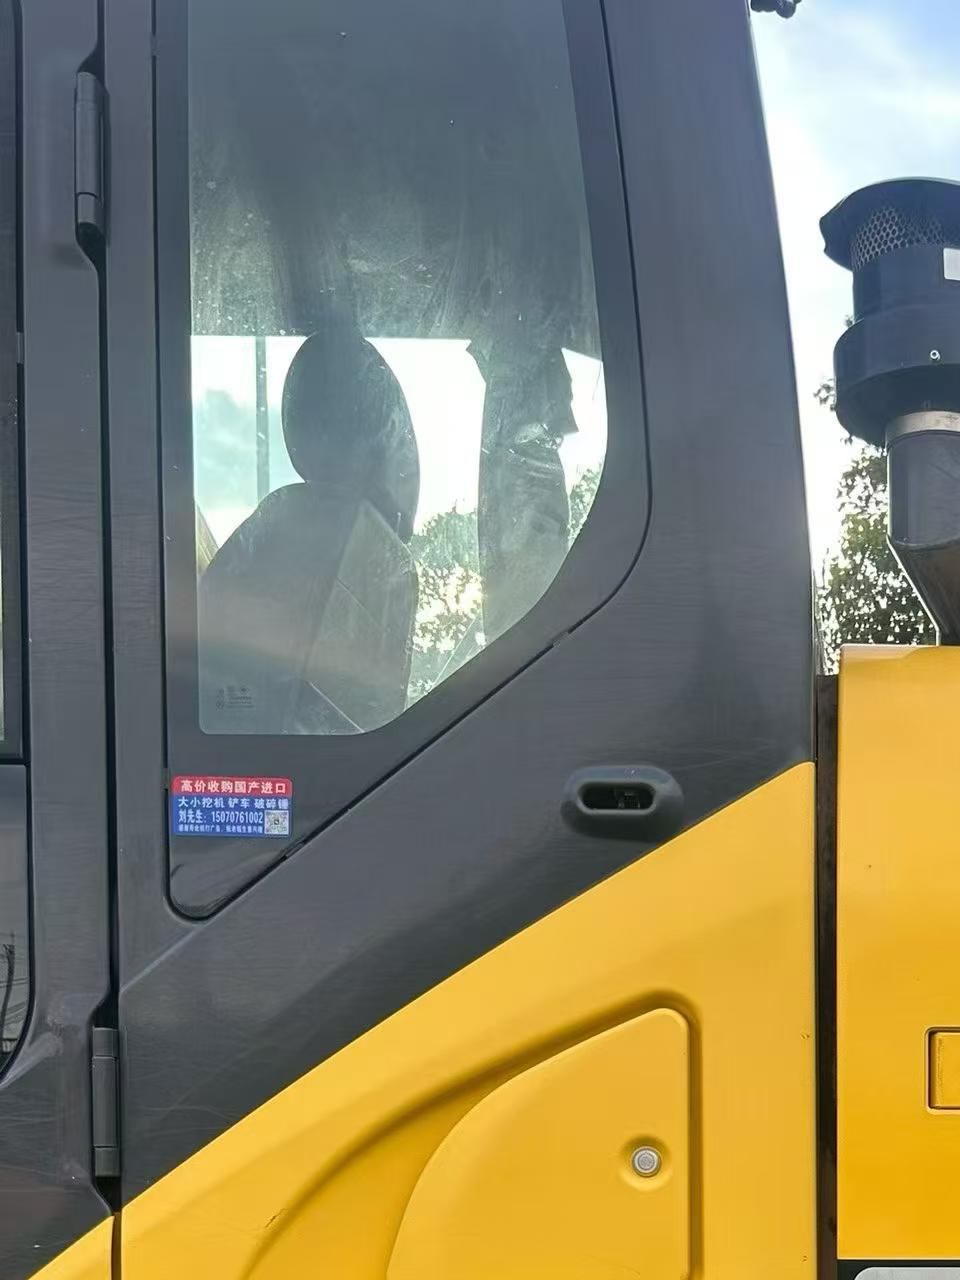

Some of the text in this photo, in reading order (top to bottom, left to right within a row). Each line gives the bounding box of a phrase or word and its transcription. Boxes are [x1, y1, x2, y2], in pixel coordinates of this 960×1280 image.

[181, 780, 286, 793] 高价收购国产进口
[178, 796, 224, 808] 大小挖机
